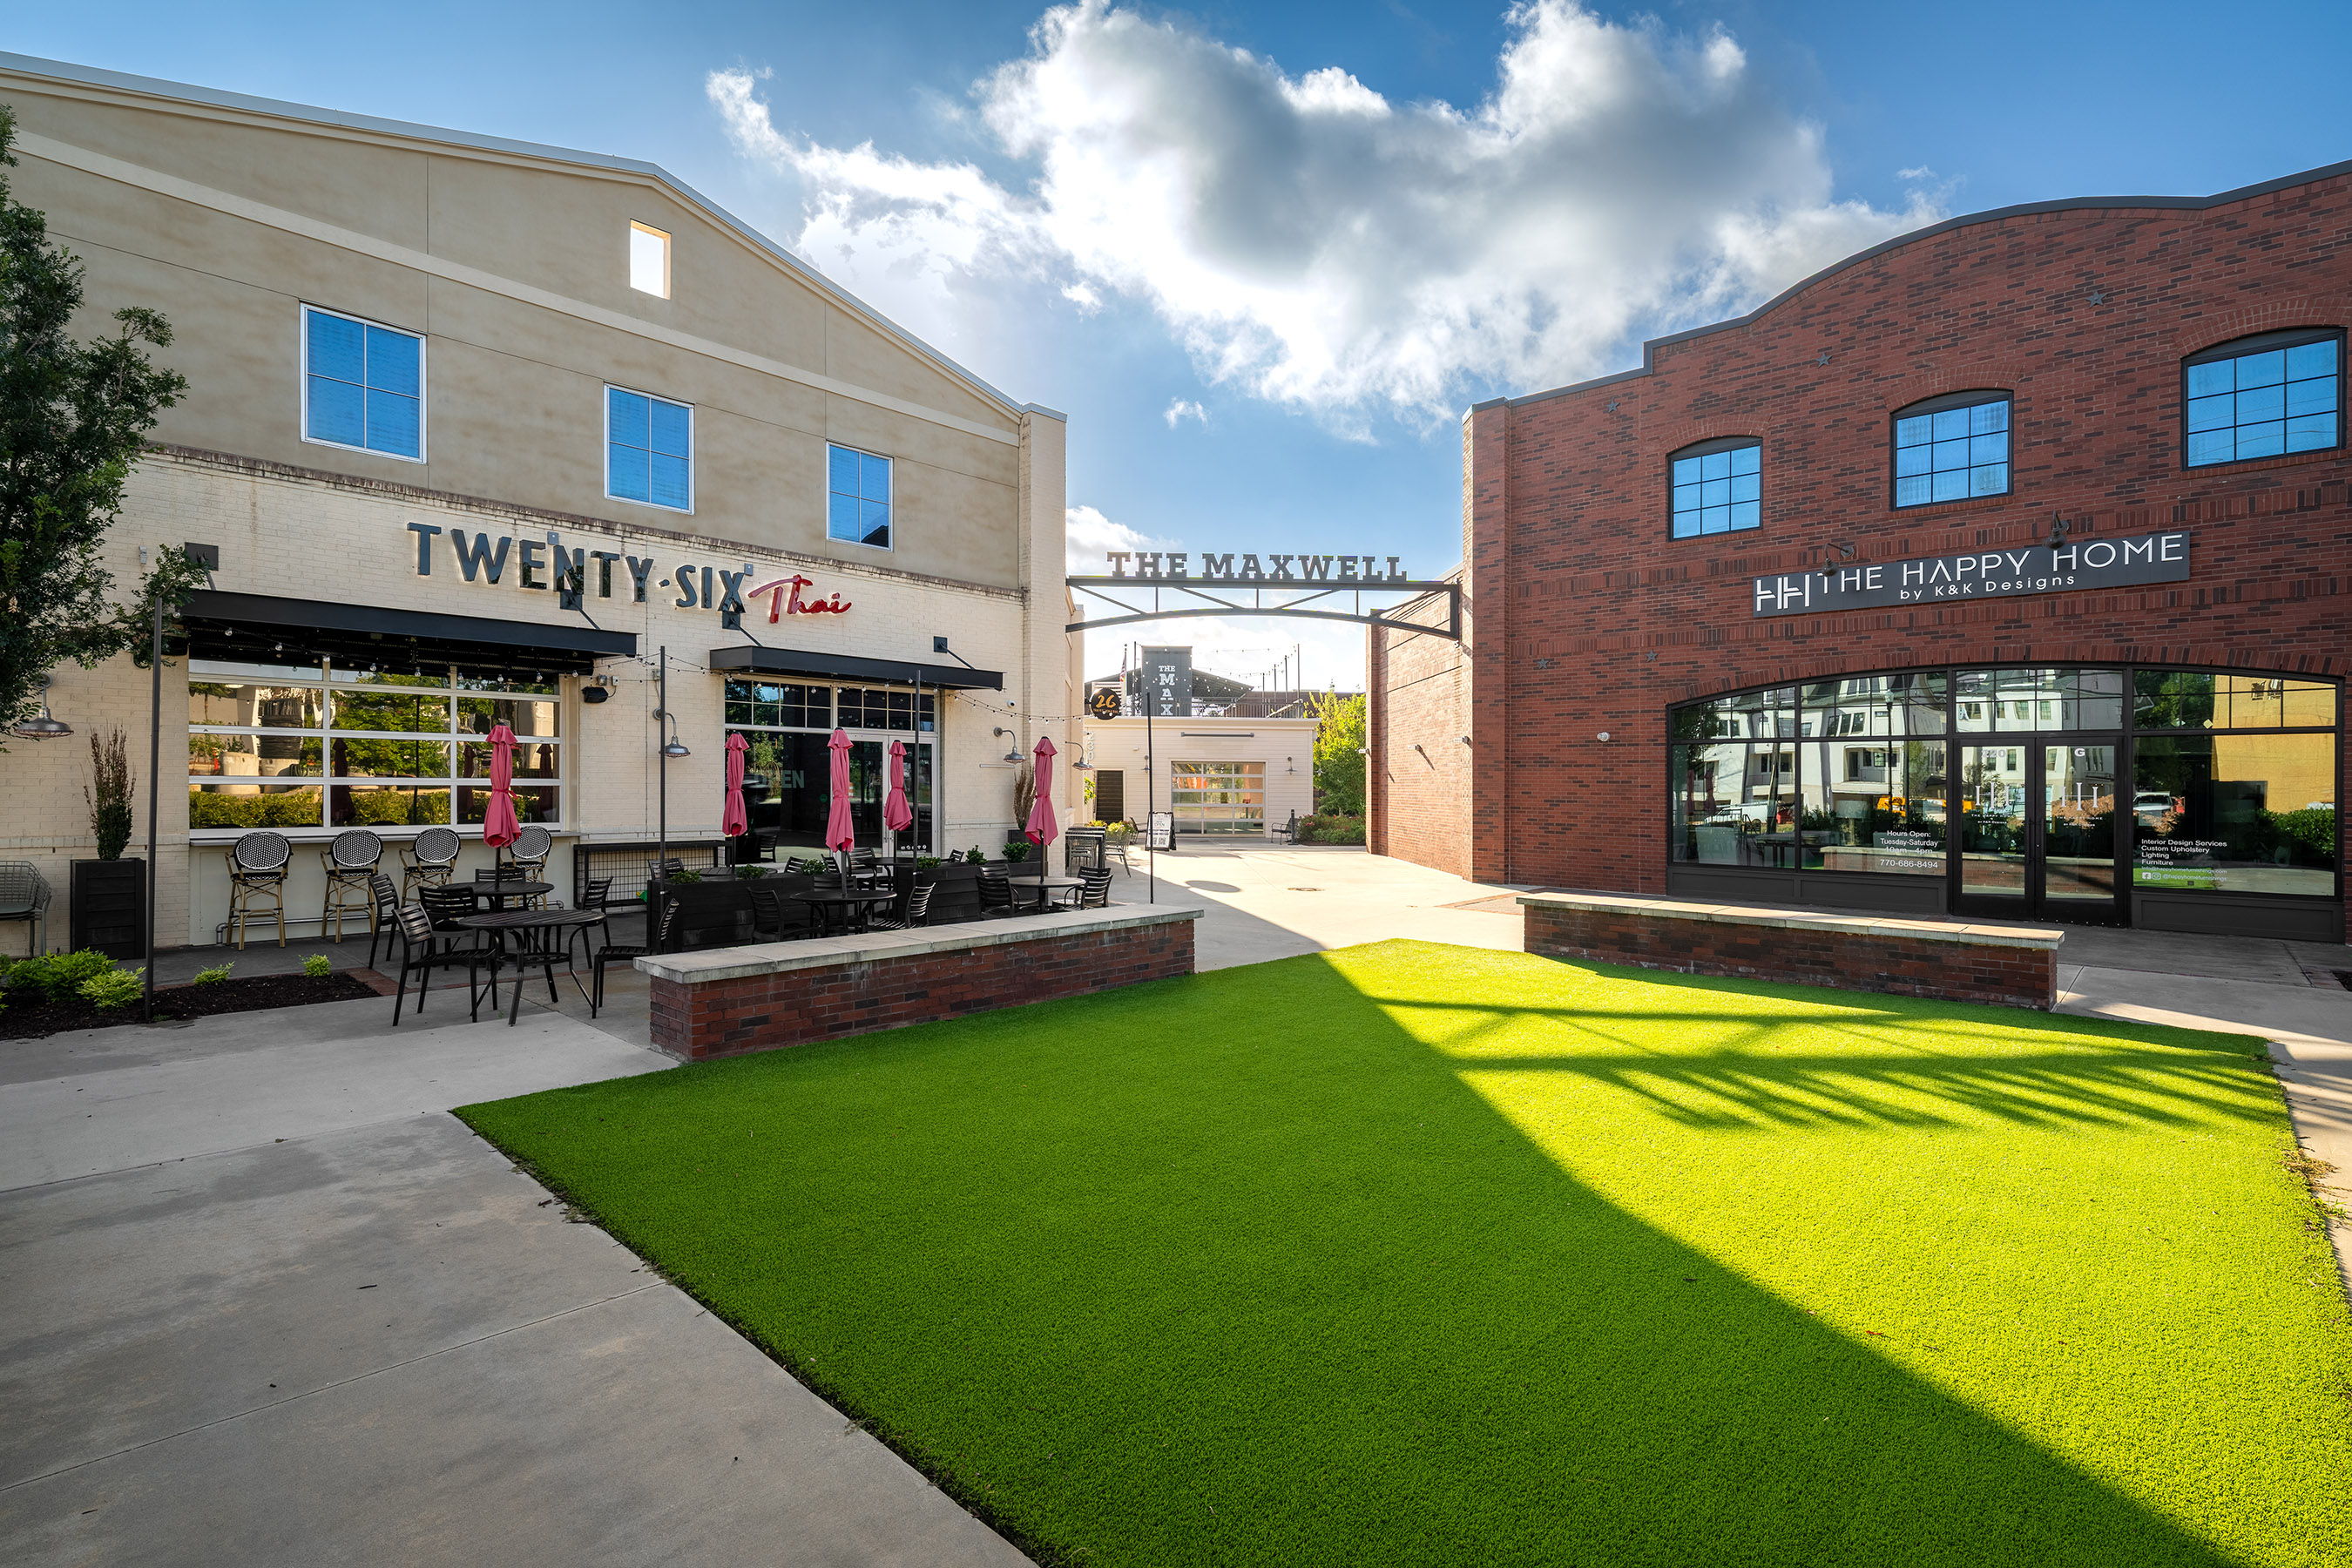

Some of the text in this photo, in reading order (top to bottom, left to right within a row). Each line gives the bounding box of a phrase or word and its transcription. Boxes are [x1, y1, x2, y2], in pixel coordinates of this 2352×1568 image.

[1106, 551, 1407, 582] THE MAXWELL
[1816, 534, 2183, 594] THE HAPPY HOME
[747, 574, 853, 624] Thai
[1900, 576, 2075, 600] by K&K Designs
[1095, 694, 1116, 708] 26
[1159, 673, 1176, 716] MAX
[1086, 732, 1095, 760] 230
[1981, 749, 2006, 758] 220
[2074, 747, 2085, 757] G
[1880, 838, 1938, 848] Tuesday-Saturday
[1880, 859, 1938, 868] 770-686-8494
